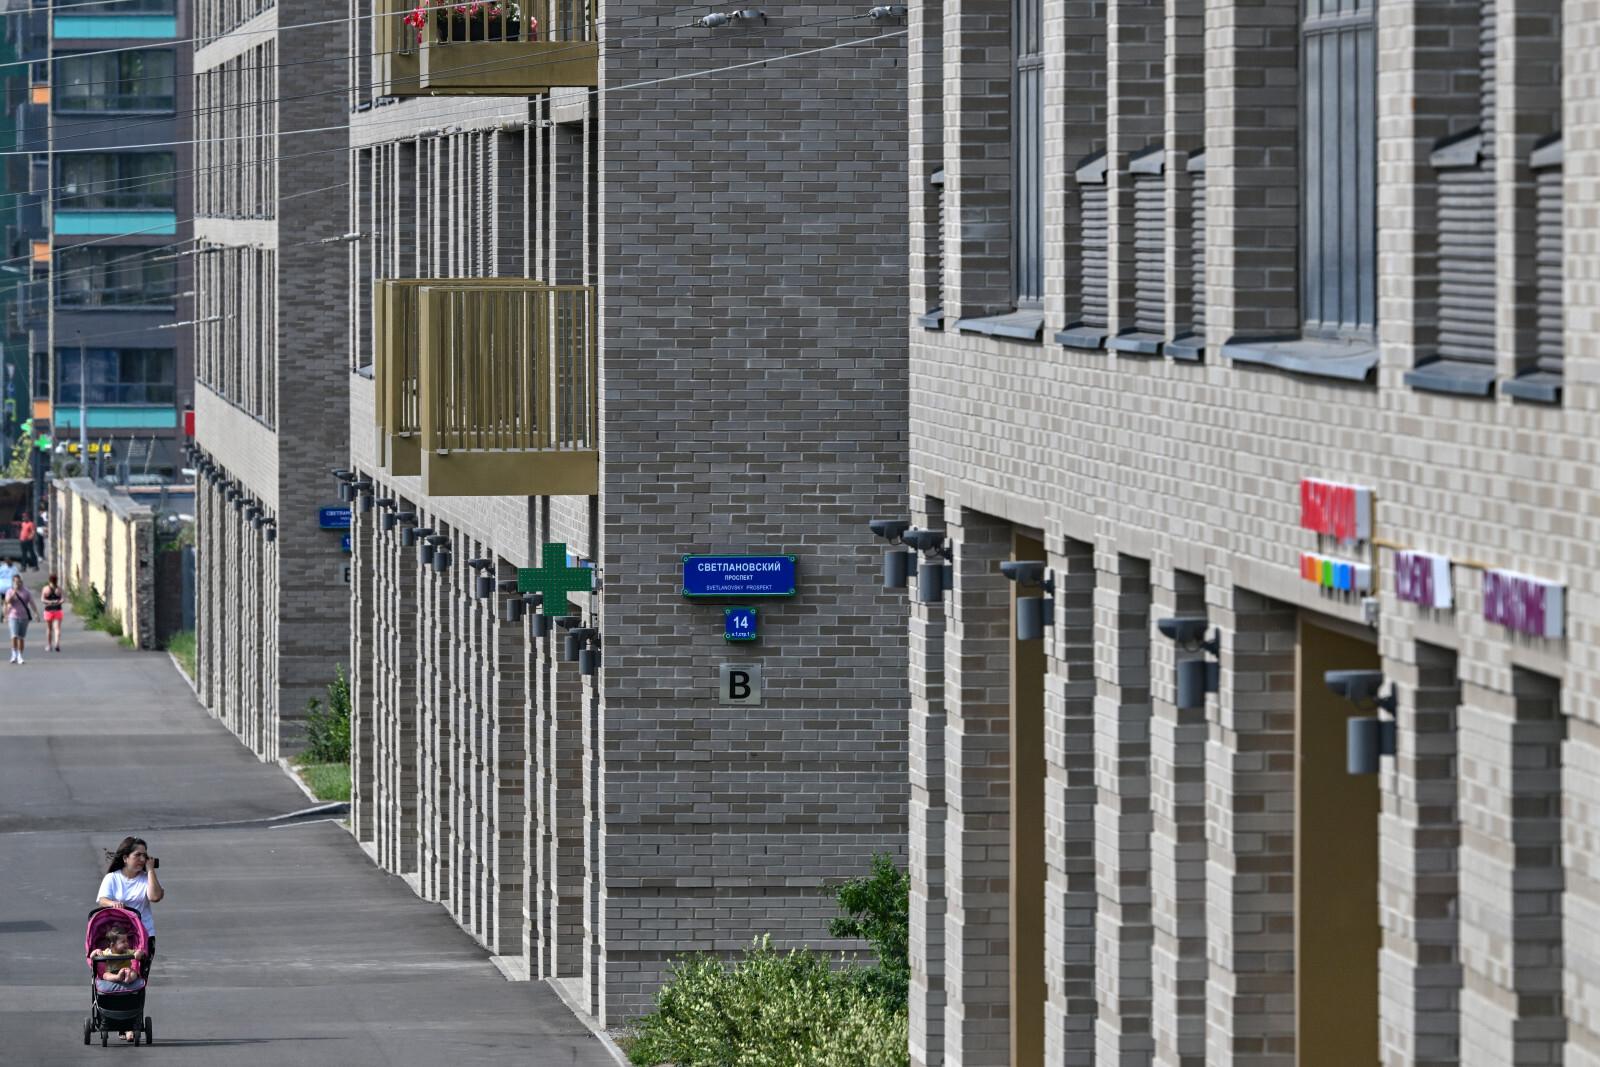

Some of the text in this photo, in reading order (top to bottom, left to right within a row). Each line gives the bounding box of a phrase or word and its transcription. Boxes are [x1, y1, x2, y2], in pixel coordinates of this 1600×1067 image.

[697, 561, 781, 572] СВЕТЛАНОВСКИЙ
[733, 616, 749, 629] 14
[729, 671, 751, 699] В
